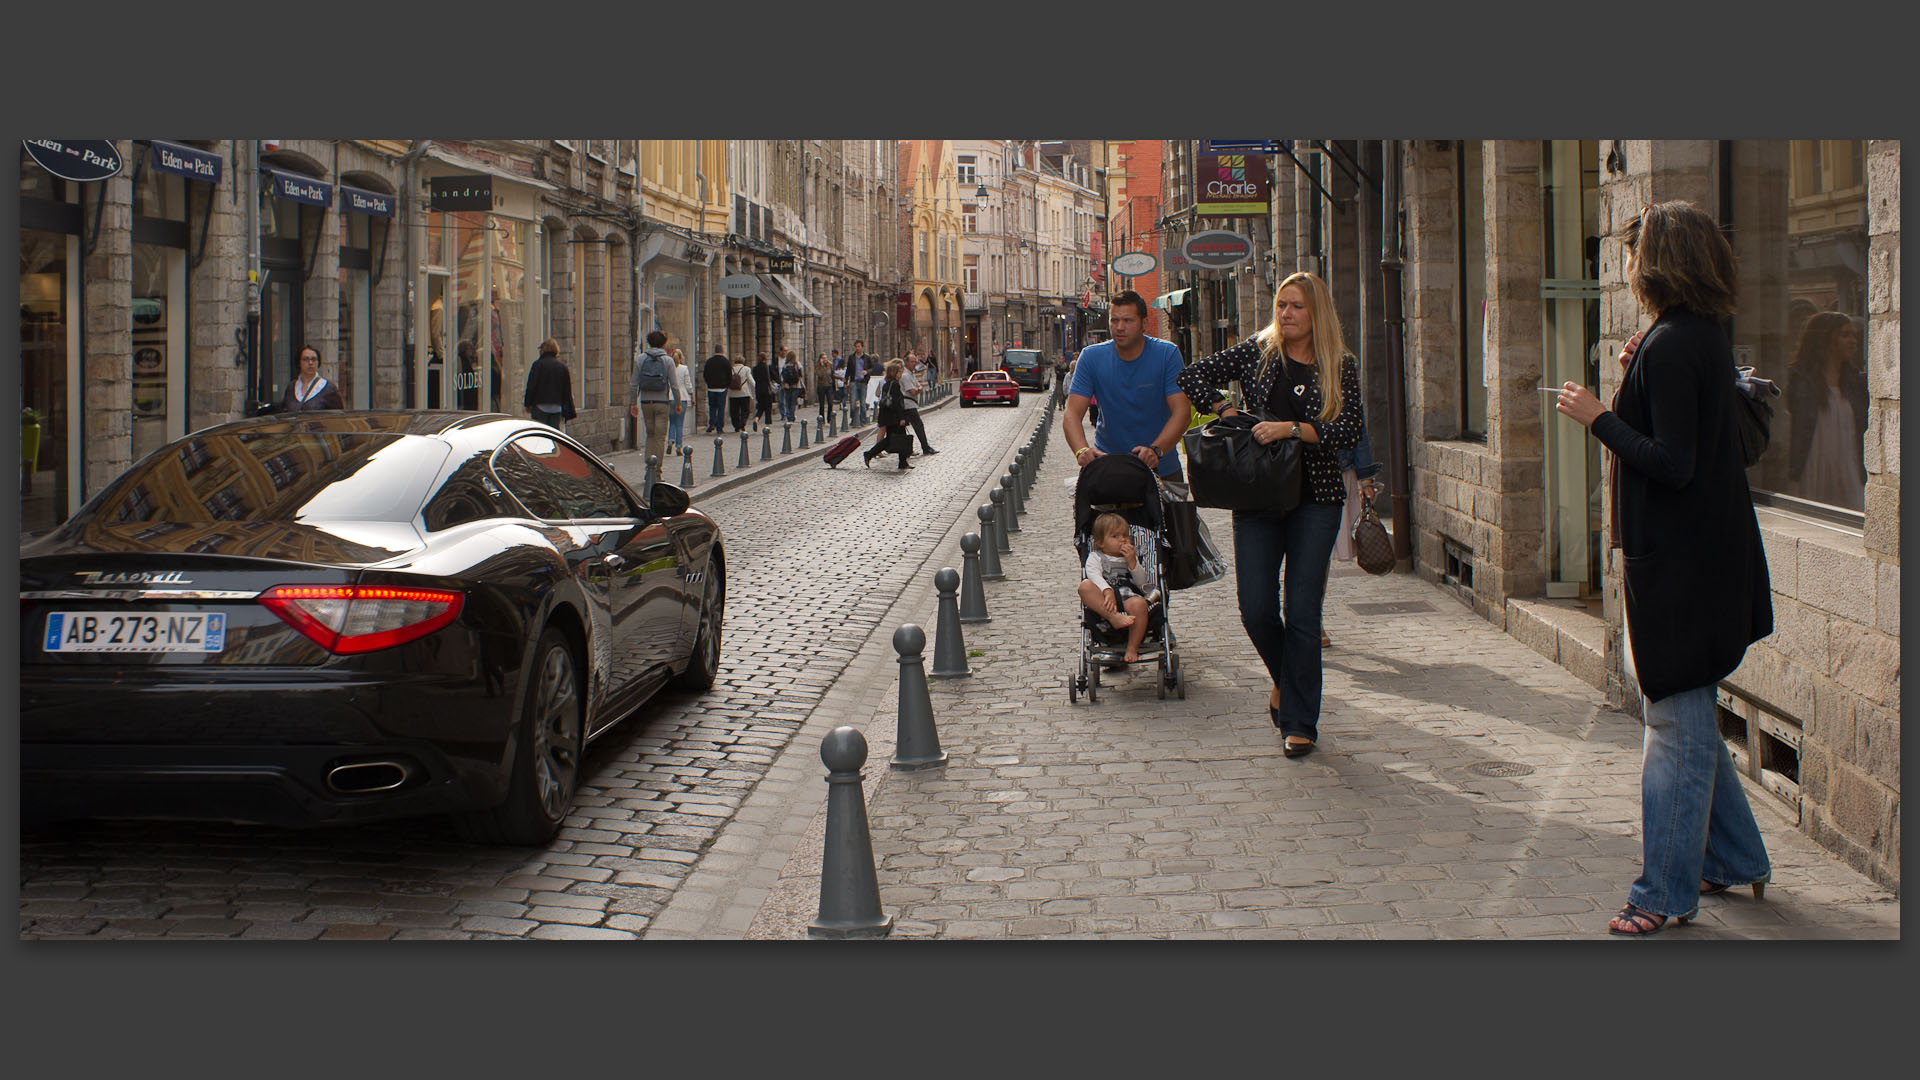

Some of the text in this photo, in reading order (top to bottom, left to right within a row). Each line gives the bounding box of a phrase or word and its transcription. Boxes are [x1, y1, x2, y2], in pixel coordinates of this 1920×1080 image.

[82, 149, 118, 171] Park
[162, 150, 215, 176] Eden Park
[284, 179, 324, 201] Eden Park
[433, 187, 490, 199] sandro
[353, 193, 387, 212] Eden Park
[453, 371, 483, 391] SOLDES
[74, 571, 193, 584] Maserati
